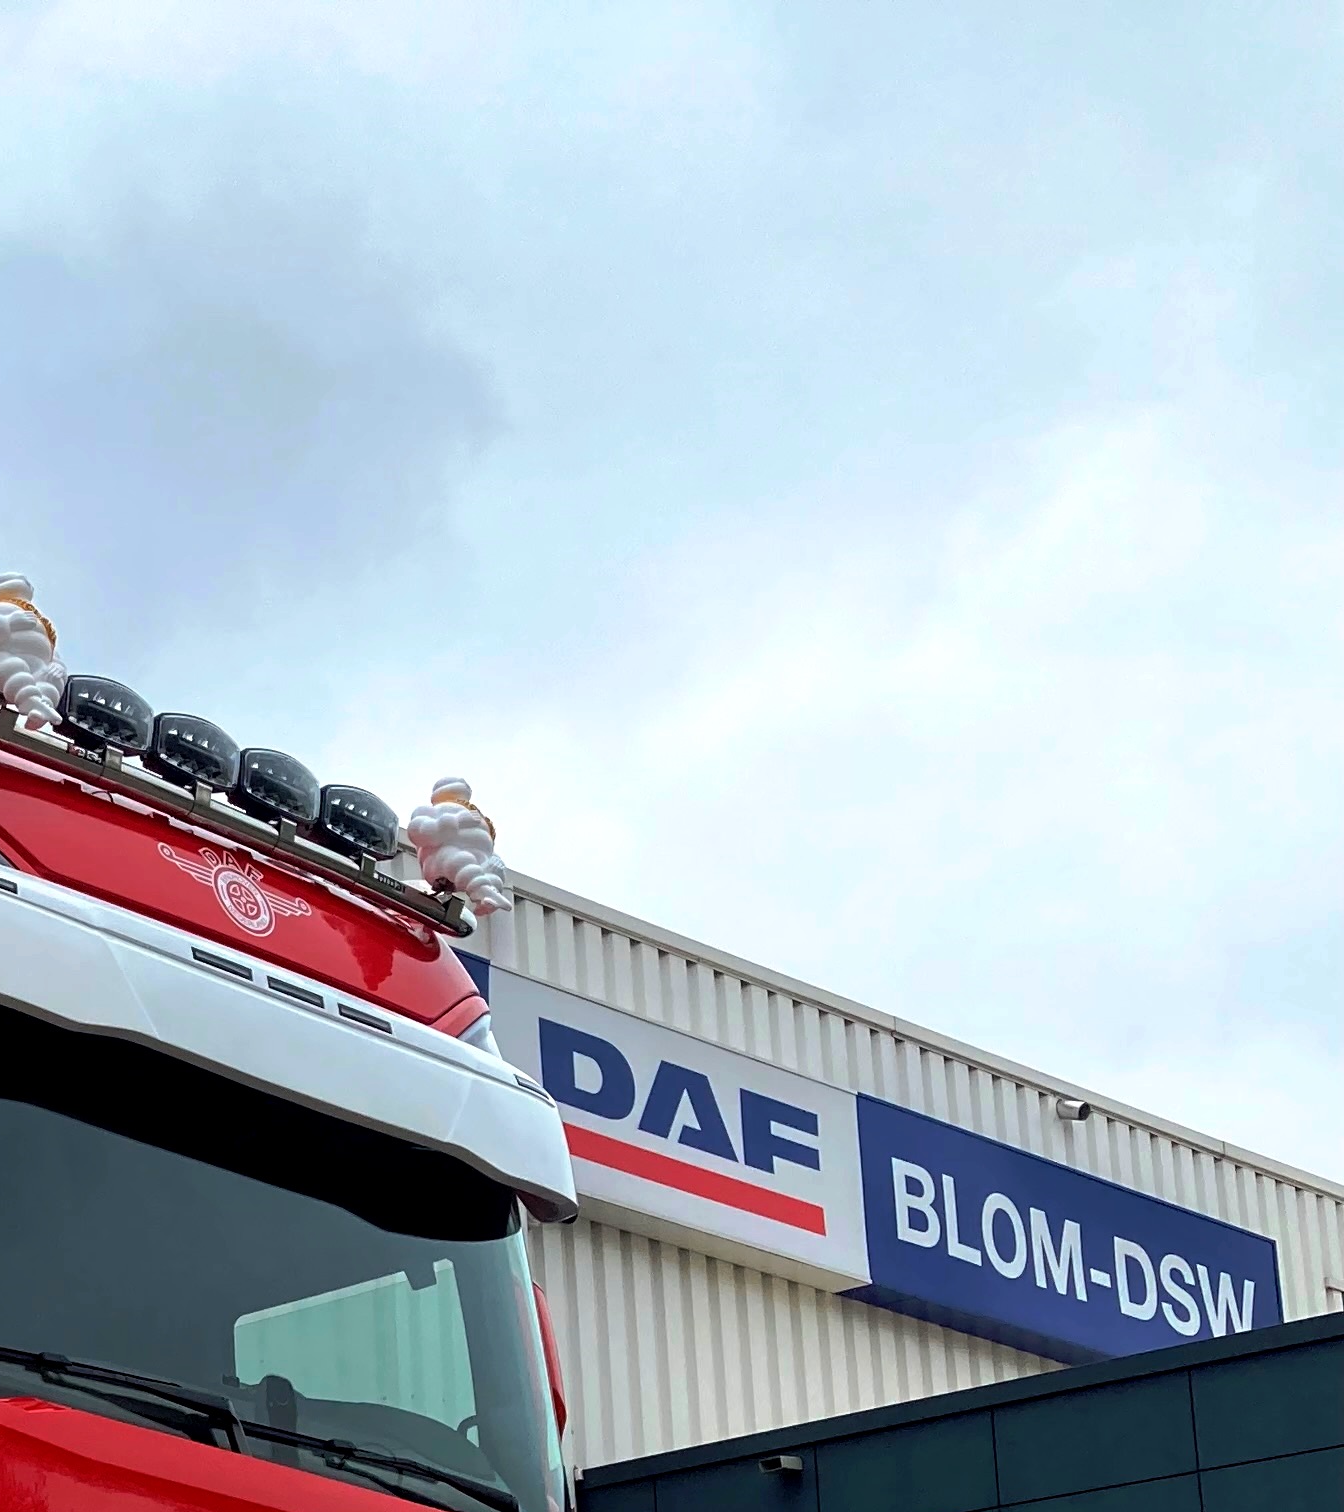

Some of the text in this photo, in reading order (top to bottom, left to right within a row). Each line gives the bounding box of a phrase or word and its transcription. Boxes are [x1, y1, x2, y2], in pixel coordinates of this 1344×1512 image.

[198, 847, 264, 881] DAF
[538, 1017, 822, 1174] DAF
[890, 1157, 1256, 1338] BLOM-DSW
